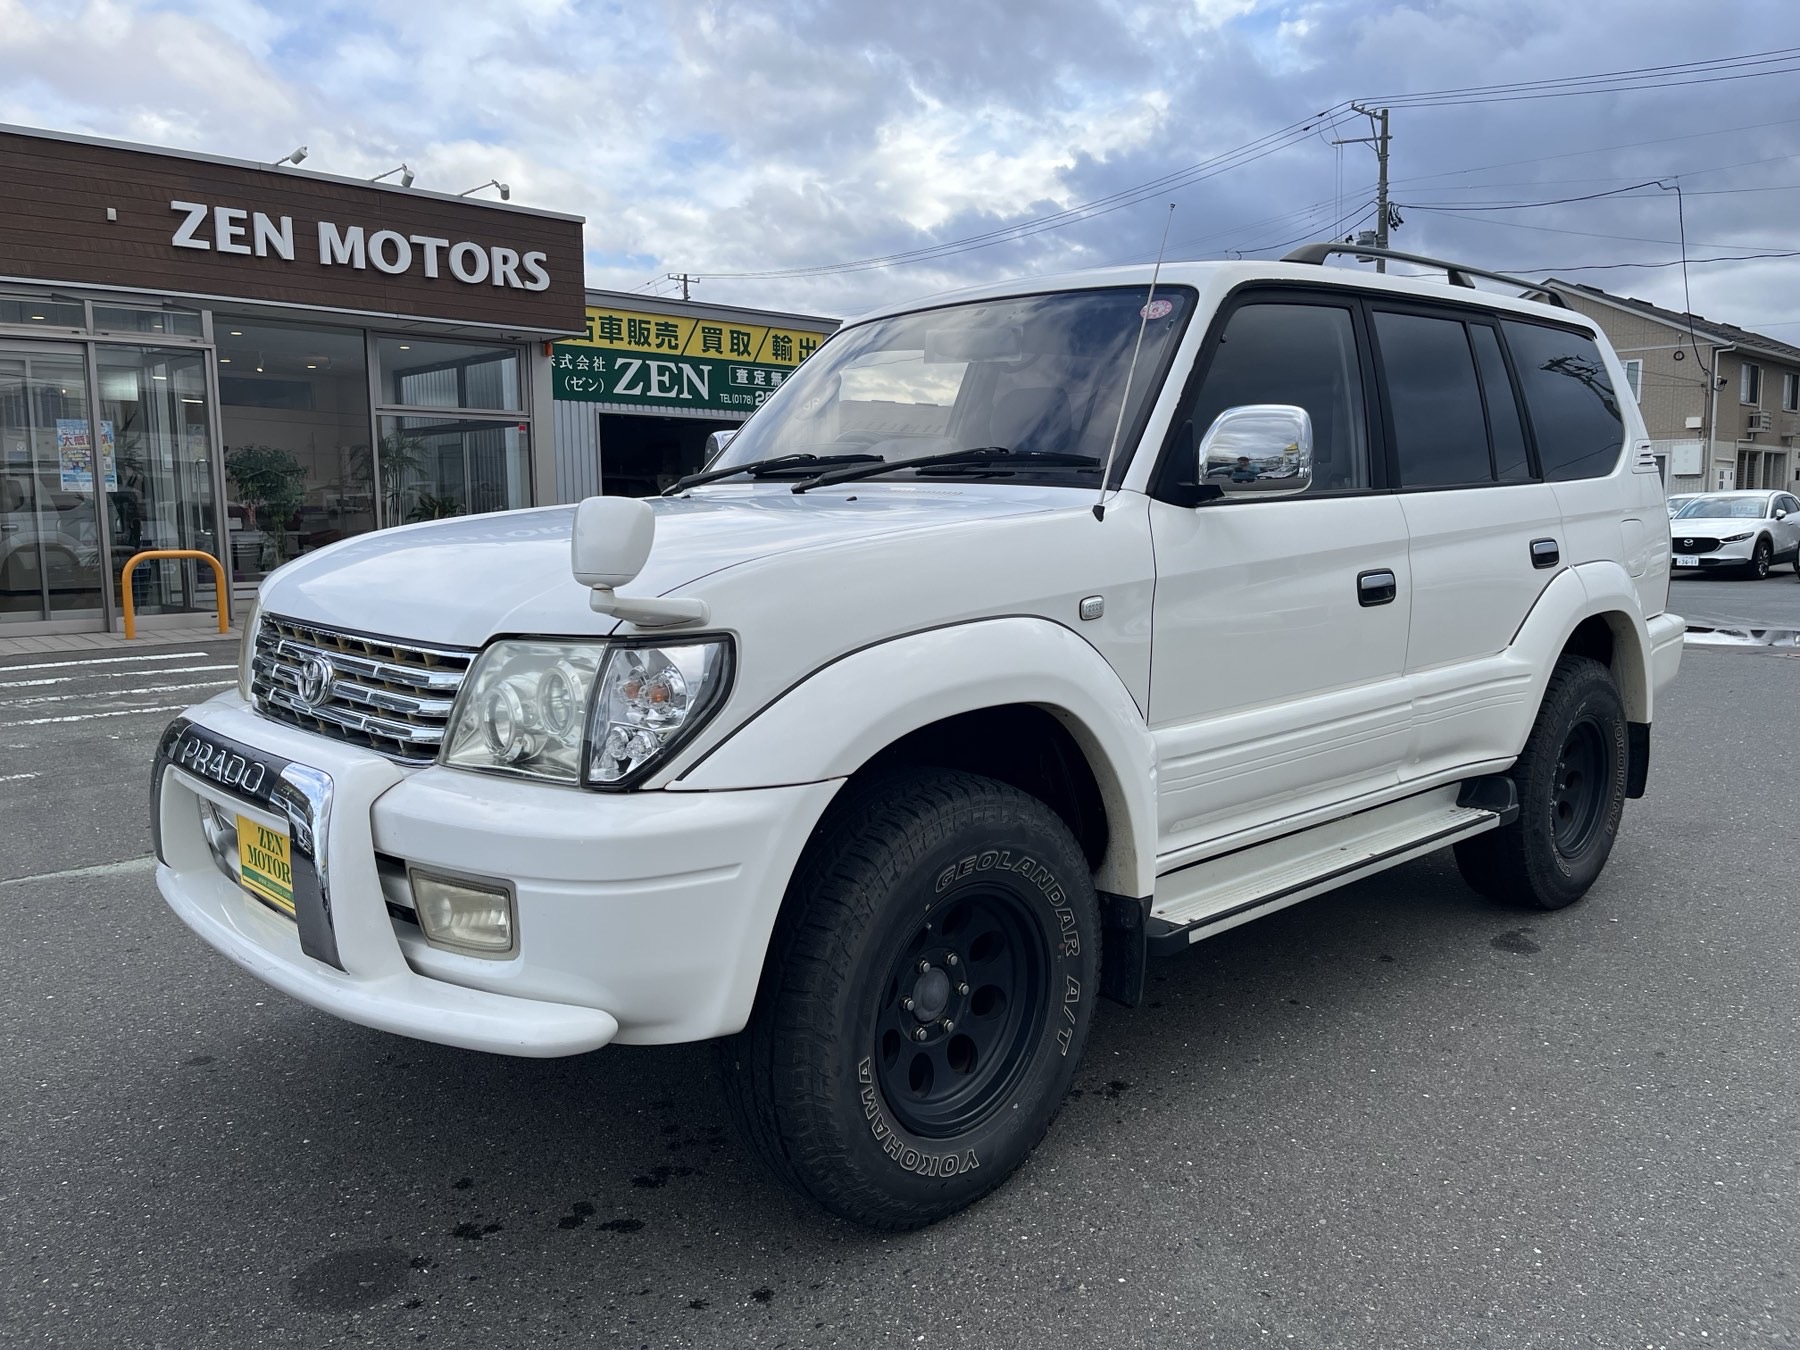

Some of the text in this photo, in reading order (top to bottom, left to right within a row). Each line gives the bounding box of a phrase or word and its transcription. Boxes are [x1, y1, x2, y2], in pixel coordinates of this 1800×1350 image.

[170, 200, 551, 292] ZEN MOTORS
[701, 326, 752, 357] 買取
[612, 357, 713, 401] ZEN
[735, 368, 792, 387] 査定無
[180, 738, 266, 793] PRADO
[257, 826, 284, 858] ZEN
[935, 850, 1081, 1056] GEOLANDAR A/T
[858, 1056, 980, 1178] YOKOHAMA
